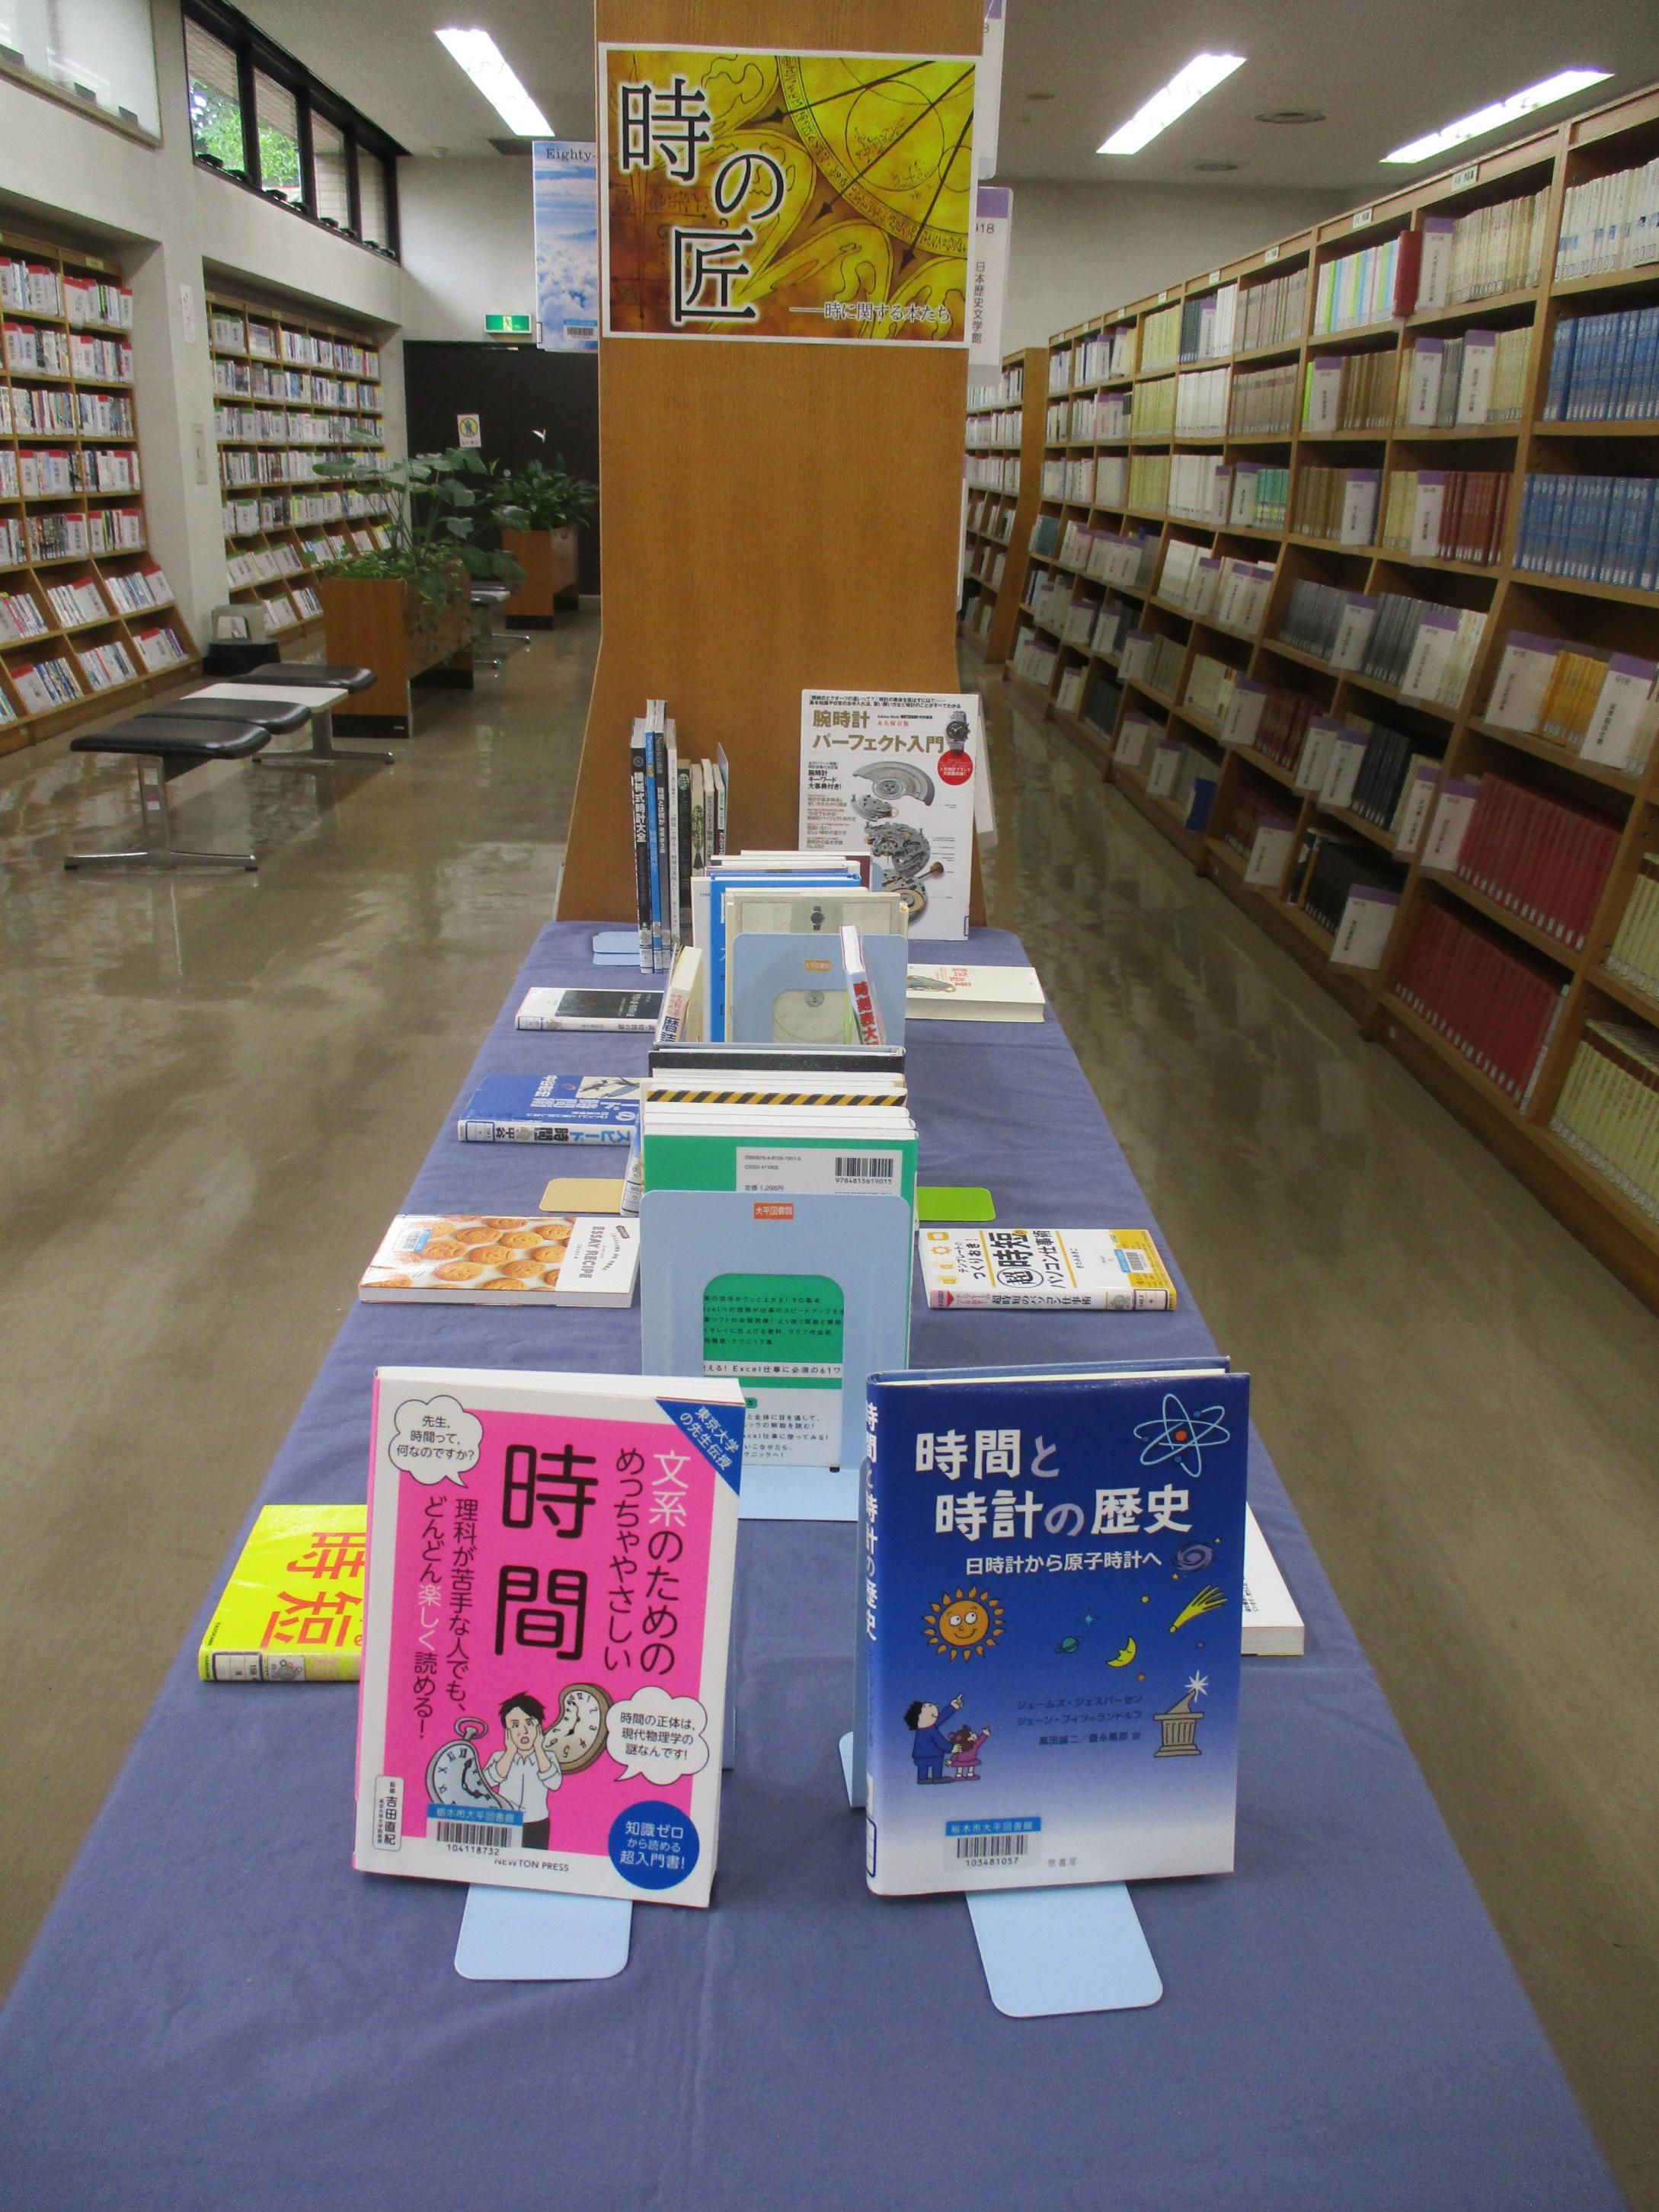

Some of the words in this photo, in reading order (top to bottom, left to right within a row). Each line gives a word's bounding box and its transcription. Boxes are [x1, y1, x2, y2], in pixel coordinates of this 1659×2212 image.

[618, 78, 785, 324] 時の匠
[972, 261, 986, 344] 日本歴史文学館
[813, 710, 870, 728] 腕時計
[812, 734, 945, 753] パーフェクト入門
[756, 1206, 793, 1216] 大平図書館
[589, 1226, 605, 1250] ESSAY
[579, 1250, 596, 1278] RECIPE
[1032, 1230, 1066, 1288] パソコン仕事術
[992, 1295, 1092, 1306] 超時短のパソコン仕事術
[679, 1411, 733, 1471] の先生伝授
[695, 1406, 740, 1453] 東京大学
[397, 1446, 475, 1460] 何なのですか?
[916, 1429, 1060, 1481] 時間と
[935, 1483, 1193, 1542] 時計の歴史
[496, 1444, 599, 1661] 時間
[605, 1447, 645, 1670] めっちゃやさしい
[641, 1449, 690, 1675] 文系のための
[966, 1550, 1162, 1576] 日時計から原子時計へ
[413, 1496, 447, 1738] どんどん楽しく読める!
[446, 1499, 478, 1712] 理科が苦手な人でも、
[622, 1728, 693, 1745] 現代物理学の
[625, 1743, 687, 1760] 謎なんです!
[384, 1796, 398, 1846] 吉田直紀
[625, 1821, 683, 1839] 知識ゼロ
[447, 1844, 500, 1856] 104118732
[628, 1838, 681, 1852] から読める
[542, 1862, 570, 1872] PRESS
[620, 1851, 685, 1869] 超入門書!
[966, 1857, 1019, 1866] 103481057
